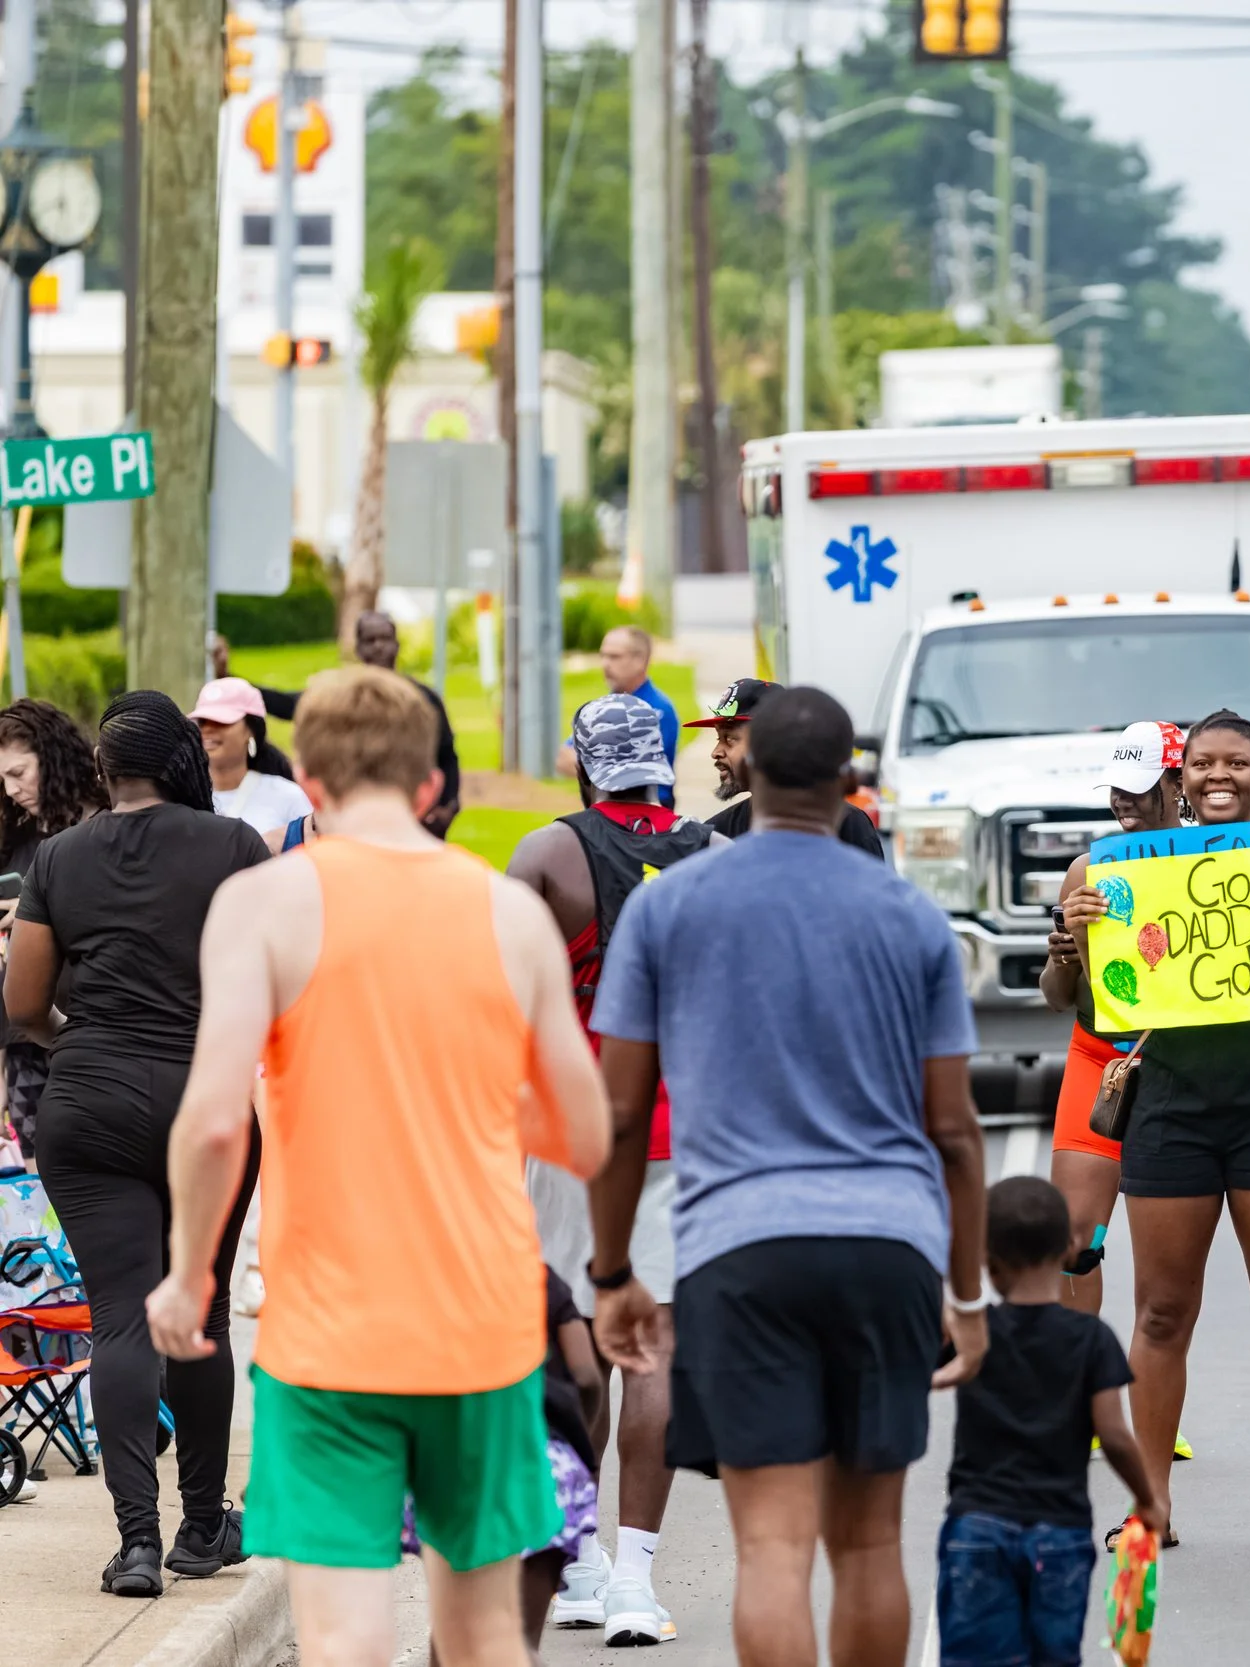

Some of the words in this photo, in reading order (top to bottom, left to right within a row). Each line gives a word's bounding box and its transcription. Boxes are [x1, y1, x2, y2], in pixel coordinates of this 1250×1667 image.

[0, 444, 95, 499] Lake
[110, 437, 149, 492] Pl
[1113, 749, 1142, 761] RUN!
